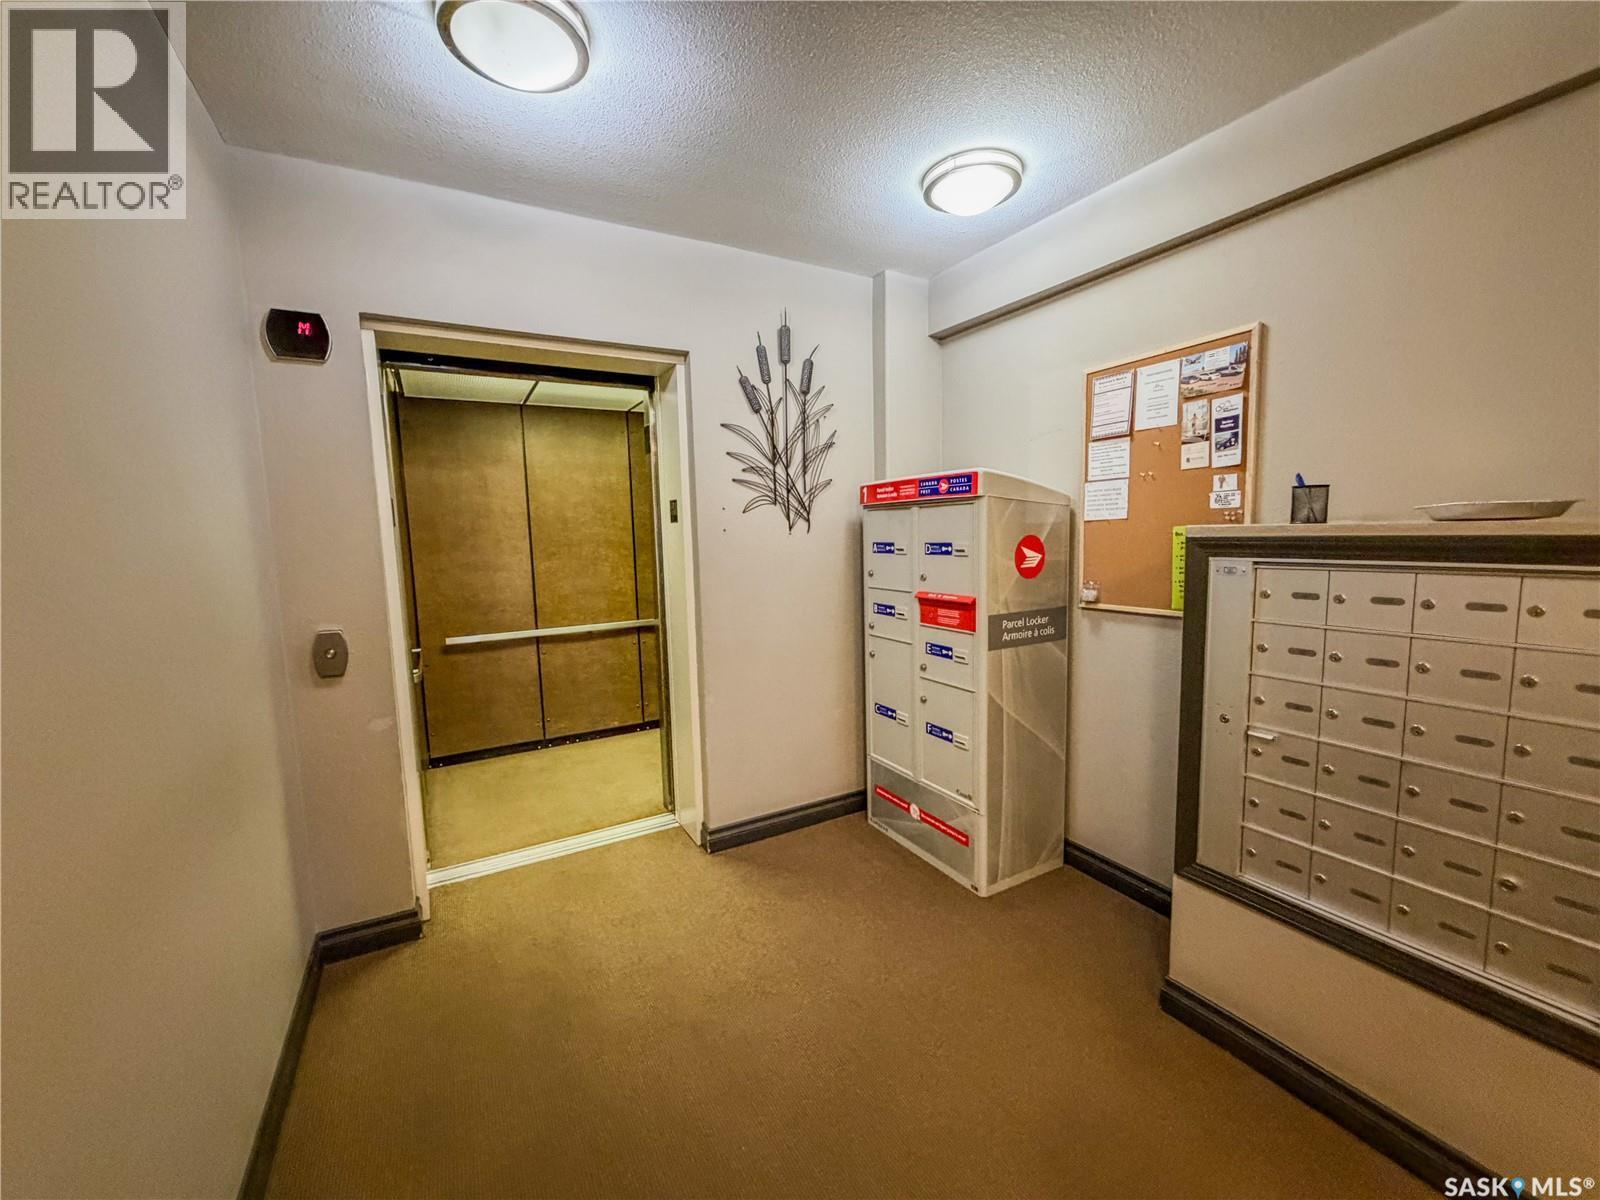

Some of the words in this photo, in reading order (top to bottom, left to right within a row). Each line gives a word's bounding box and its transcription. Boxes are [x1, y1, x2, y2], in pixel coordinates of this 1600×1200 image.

[297, 321, 311, 336] M
[925, 544, 931, 554] D
[1002, 617, 1025, 629] Parcel
[1026, 615, 1049, 626] Locker
[1002, 630, 1033, 641] Armoire
[1033, 628, 1038, 637] à
[1039, 625, 1055, 636] colis
[926, 643, 932, 654] E
[927, 724, 932, 734] F
